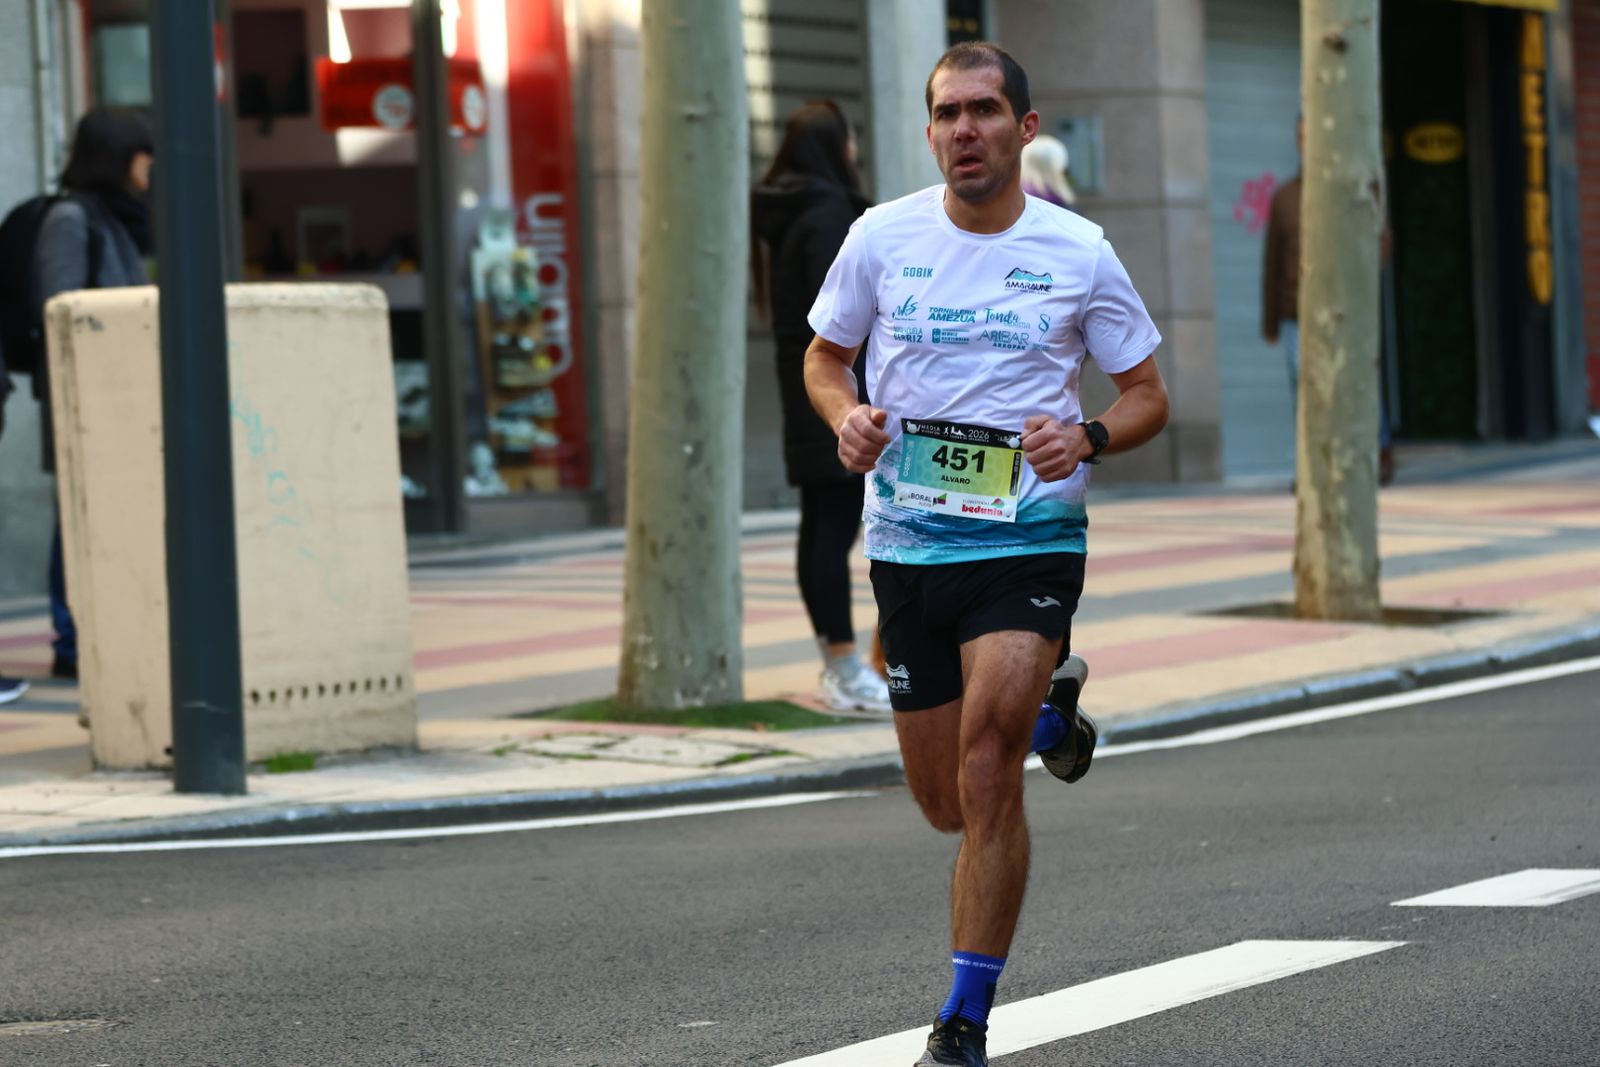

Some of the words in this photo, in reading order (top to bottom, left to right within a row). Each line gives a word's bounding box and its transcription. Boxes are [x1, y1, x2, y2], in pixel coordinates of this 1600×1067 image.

[902, 266, 934, 278] GOBIK
[1005, 281, 1053, 292] AMARAUNE
[927, 312, 976, 323] AMEZUA
[977, 329, 1030, 346] ARIBAR
[967, 429, 990, 440] 2026
[932, 446, 985, 473] 451
[940, 475, 971, 485] ALVARO
[908, 492, 932, 503] BORAL
